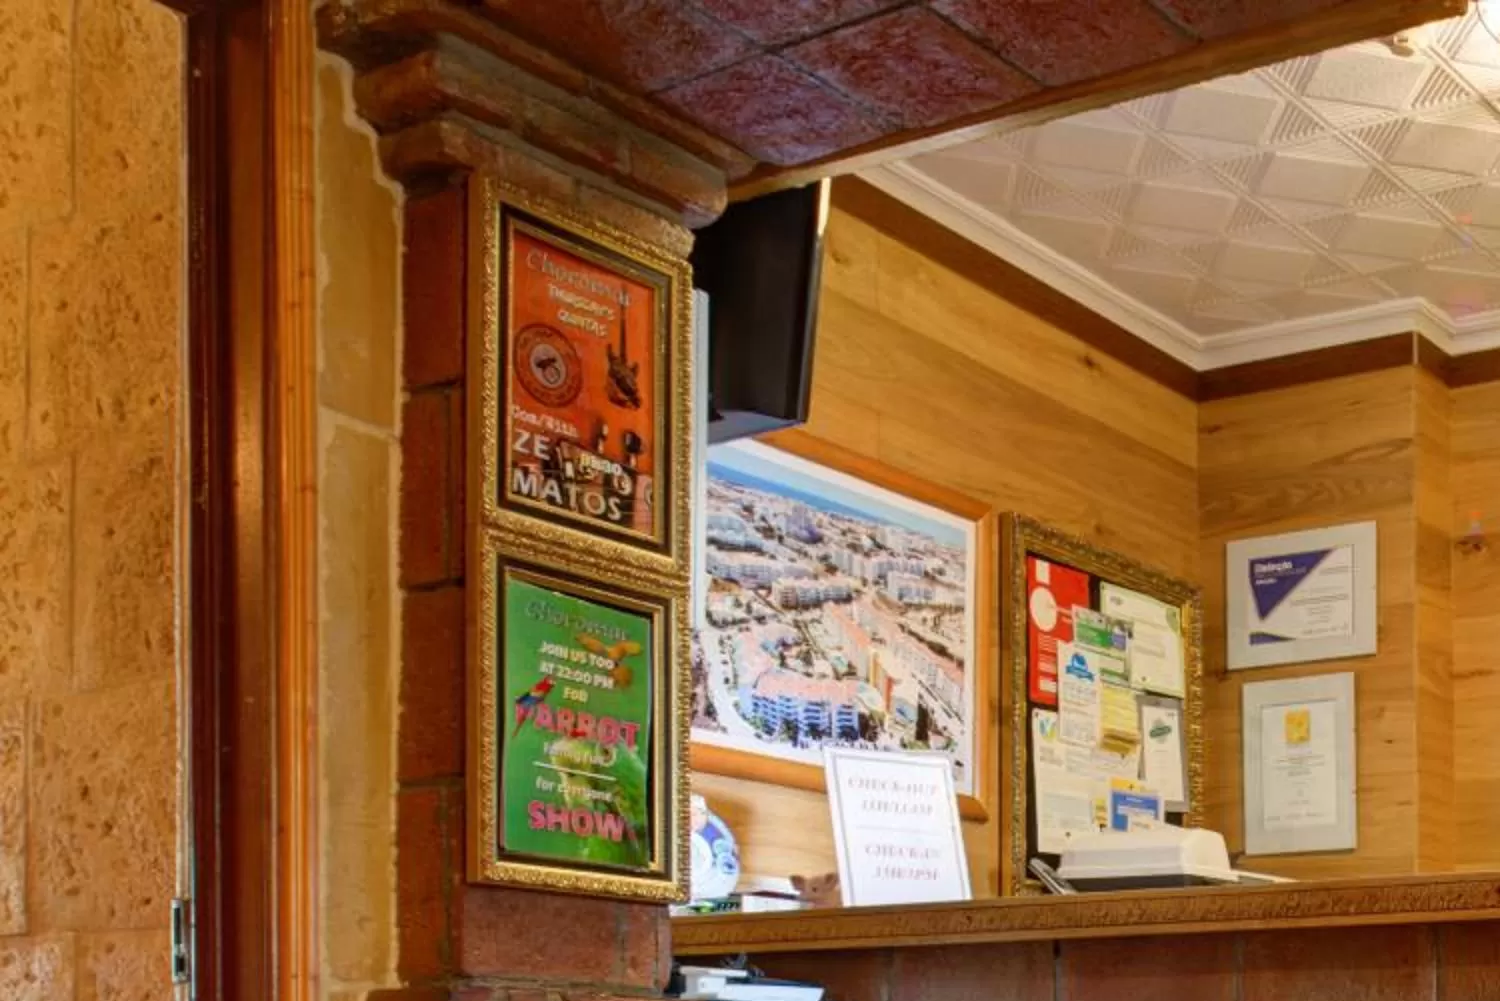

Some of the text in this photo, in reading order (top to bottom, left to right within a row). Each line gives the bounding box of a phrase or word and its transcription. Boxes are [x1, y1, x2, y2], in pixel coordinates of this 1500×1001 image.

[513, 467, 622, 521] MATOS
[539, 641, 568, 660] JOIN
[528, 800, 625, 842] SHOW
